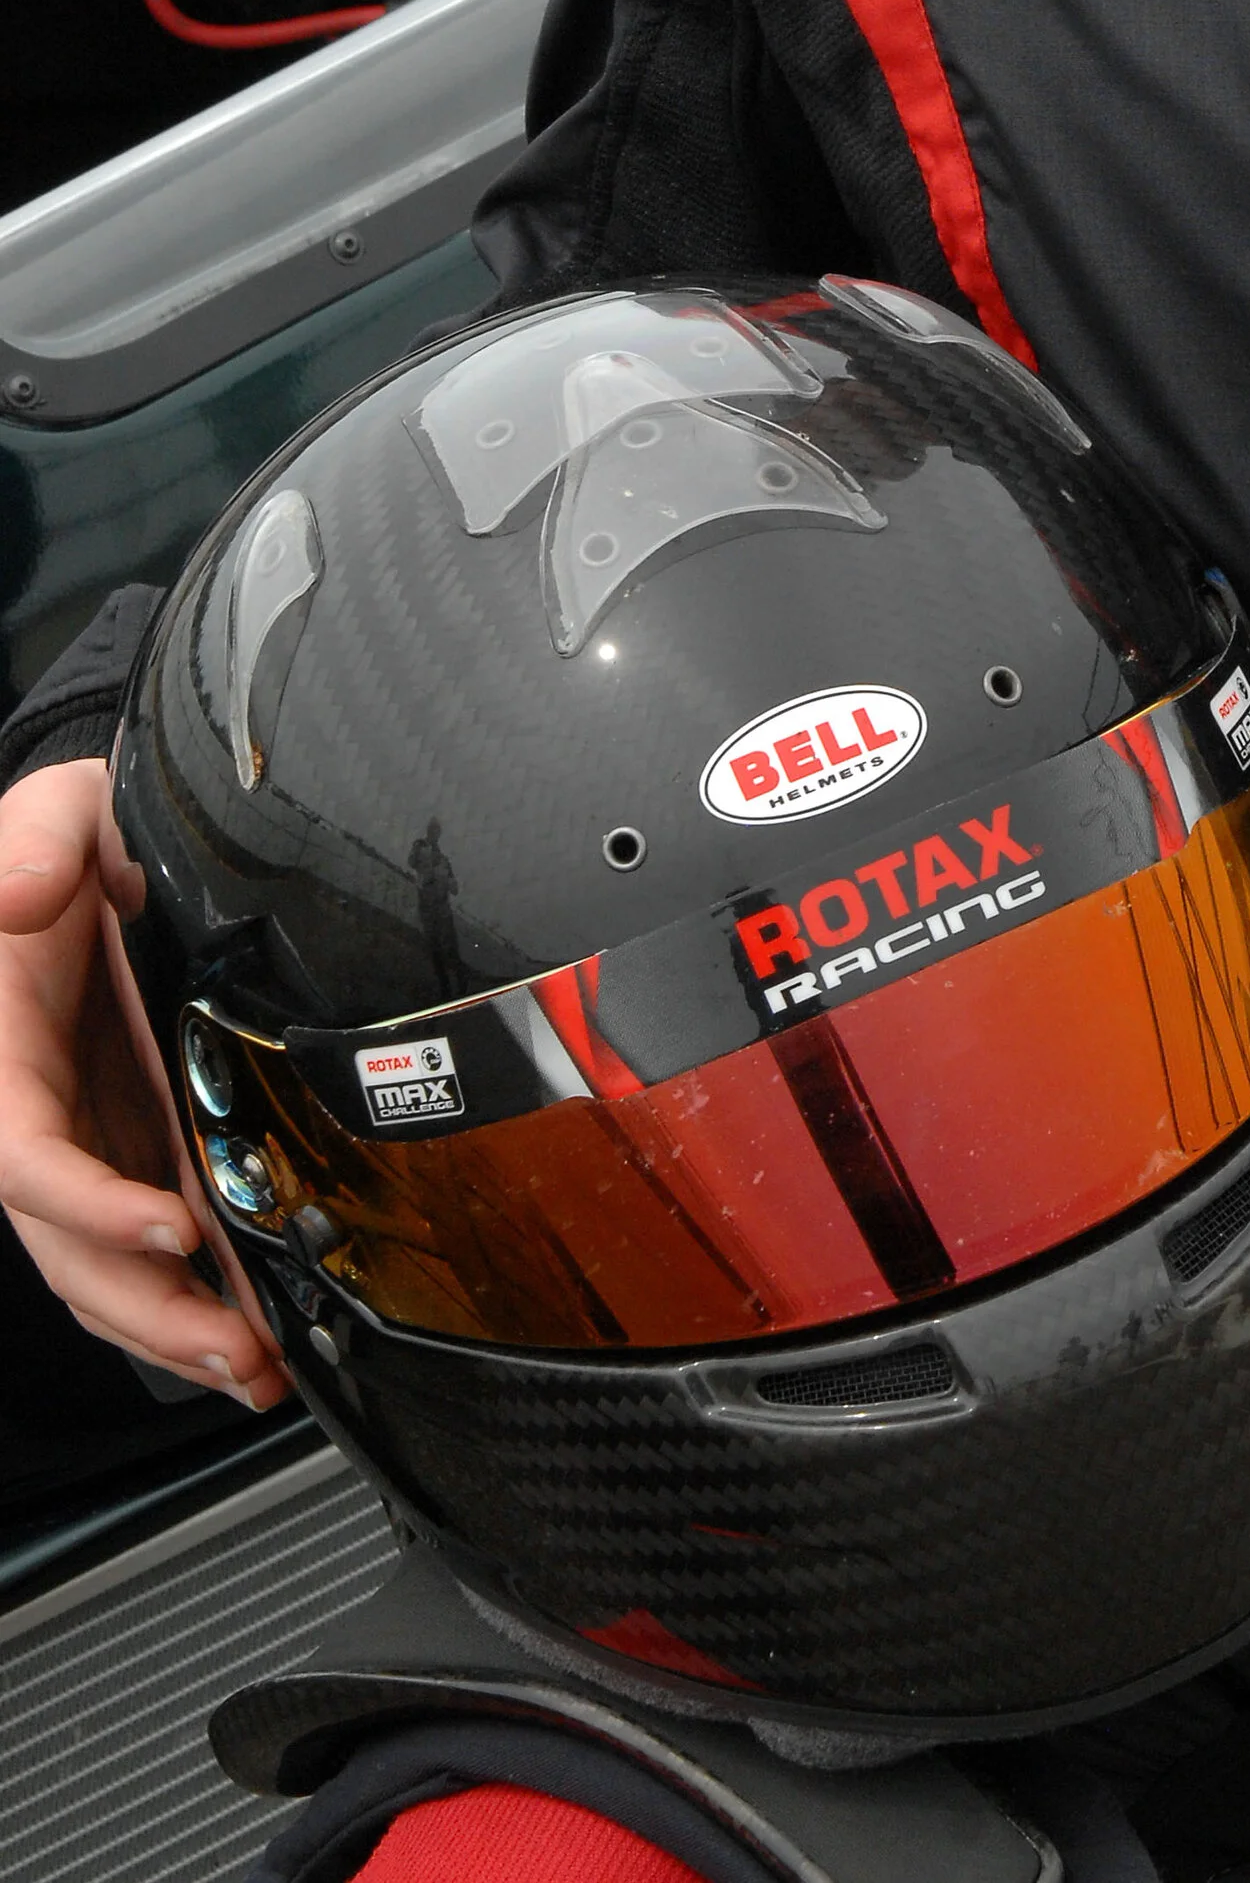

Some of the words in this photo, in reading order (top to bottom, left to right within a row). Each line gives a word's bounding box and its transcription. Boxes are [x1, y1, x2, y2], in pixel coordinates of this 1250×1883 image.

[1218, 691, 1240, 719] ROTAX
[729, 707, 898, 802] BELL
[768, 756, 885, 809] HELMETS
[735, 804, 1033, 979] ROTAX
[763, 870, 1046, 1014] RACING
[366, 1056, 414, 1073] ROTAX
[373, 1079, 452, 1109] MAX
[380, 1100, 455, 1118] CHALLENGE
